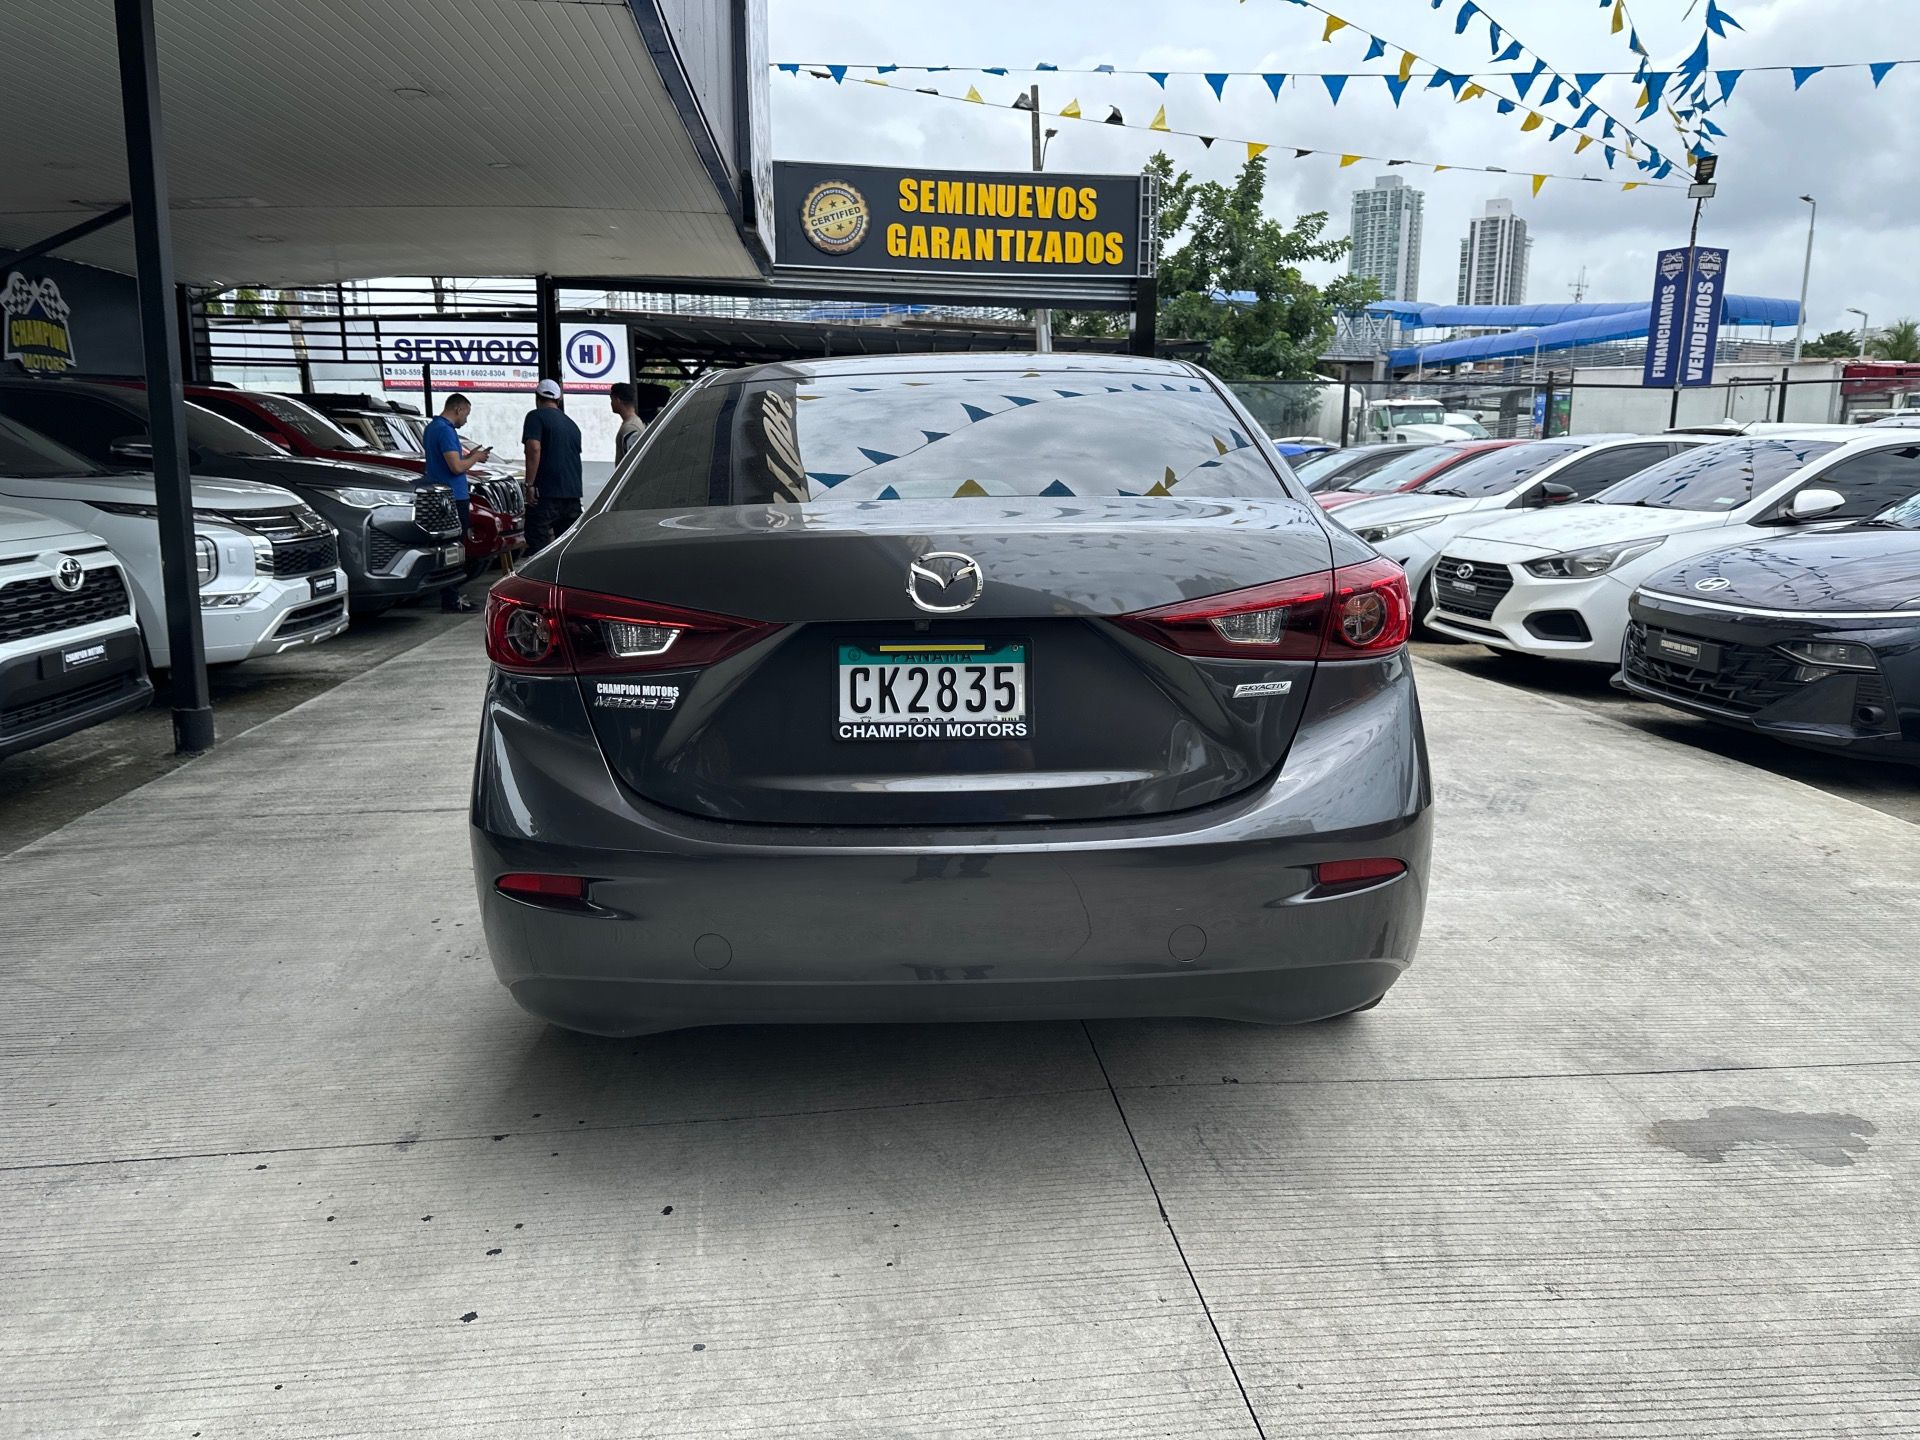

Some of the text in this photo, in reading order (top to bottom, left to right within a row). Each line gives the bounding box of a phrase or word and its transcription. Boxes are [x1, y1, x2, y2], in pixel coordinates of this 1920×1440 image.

[899, 177, 1098, 221] SEMINUEVOS
[811, 206, 861, 227] CERTIFIED
[886, 222, 1124, 265] GARANTIZADOS
[11, 319, 68, 353] CHAMPION
[1652, 284, 1676, 378] FINANCIAMOS
[1686, 281, 1715, 381] VENDEMOS
[23, 353, 67, 372] MOTORS
[394, 338, 538, 363] SERVICIO
[394, 368, 424, 376] 830-559
[597, 683, 680, 698] CHAMPION MOTORS
[850, 666, 1016, 714] CK2835
[1240, 683, 1287, 692] SKYACTIV
[839, 723, 1028, 739] CHAMPION MOTORS
